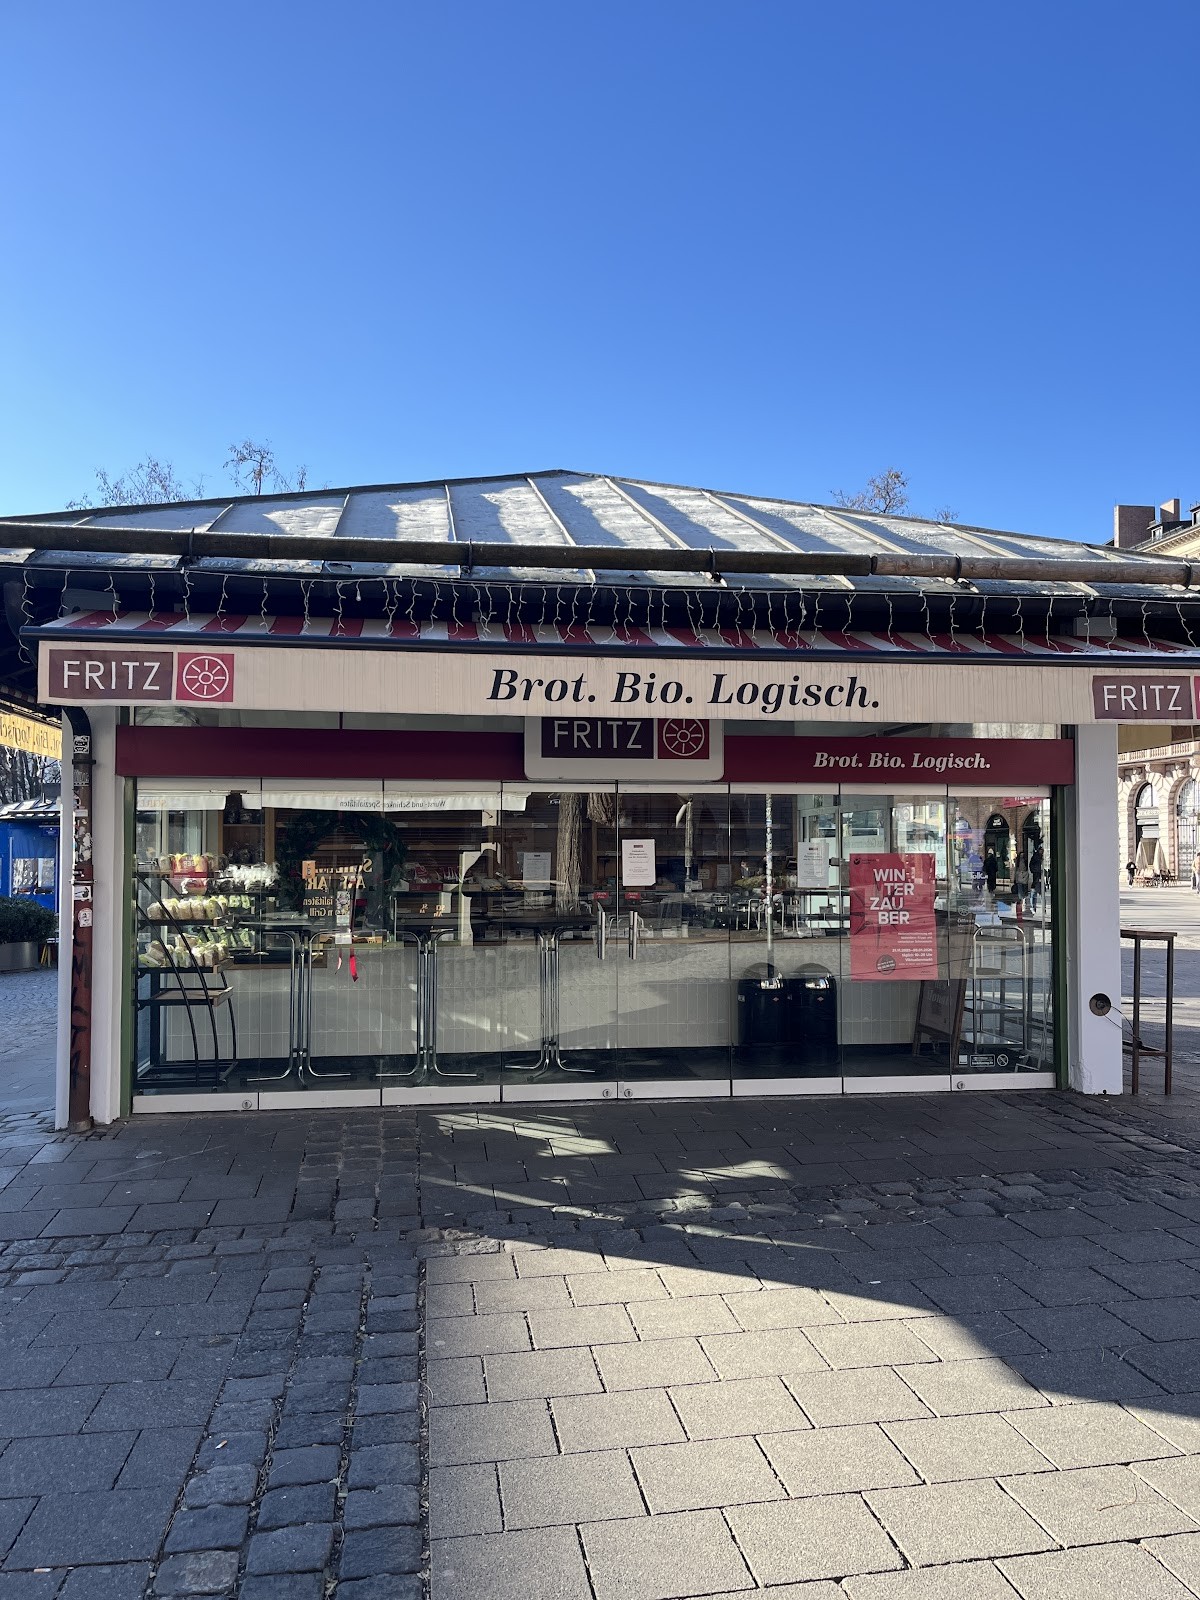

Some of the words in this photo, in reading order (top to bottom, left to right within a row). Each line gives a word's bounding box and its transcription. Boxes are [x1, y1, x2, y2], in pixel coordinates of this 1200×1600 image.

[62, 660, 161, 690] FRITZ
[487, 668, 596, 702] Brot.
[610, 671, 694, 704] Bio.
[707, 673, 880, 714] Logisch.
[1102, 684, 1183, 712] FRITZ
[553, 719, 642, 749] FRITZ
[813, 751, 863, 768] Brot.
[868, 752, 906, 769] Bio.
[912, 752, 991, 772] Logisch.
[873, 868, 906, 882] WIN
[884, 882, 915, 896] TER
[869, 897, 905, 910] ZAU
[878, 911, 910, 925] BER
